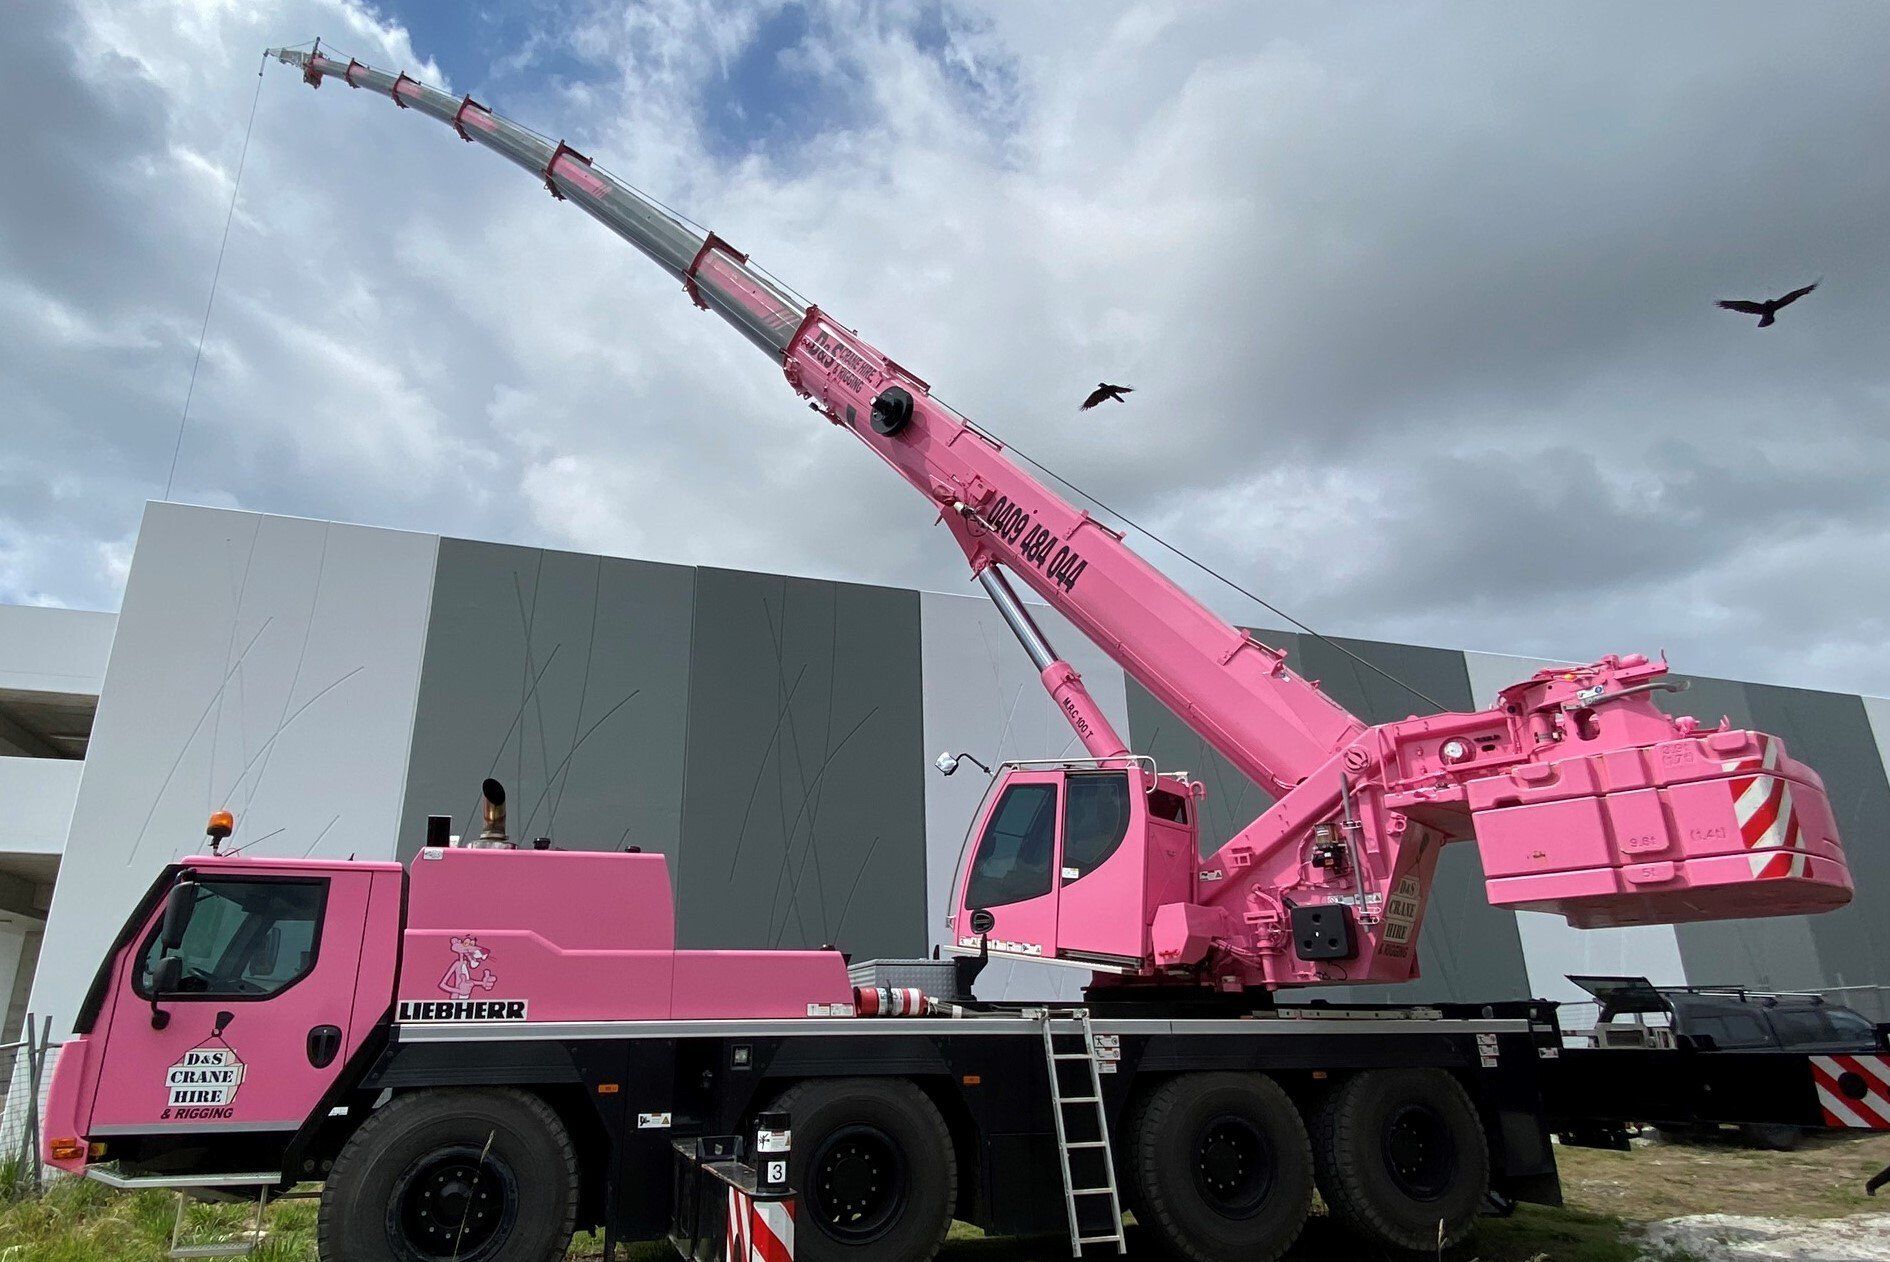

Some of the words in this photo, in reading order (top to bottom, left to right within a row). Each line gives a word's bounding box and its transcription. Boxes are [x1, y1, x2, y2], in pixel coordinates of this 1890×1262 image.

[807, 330, 845, 368] D&S
[987, 496, 1029, 545] 0409
[1019, 523, 1059, 569] 484
[1047, 545, 1088, 593] 044
[1076, 717, 1089, 733] 100
[1085, 730, 1094, 739] T
[1388, 899, 1417, 918] CRANE
[1385, 923, 1408, 939] HIRE
[400, 1001, 526, 1020] LIEBHERR
[186, 1053, 223, 1066] D&S
[170, 1070, 234, 1084] CRANE
[173, 1090, 223, 1103] HIRE
[161, 1108, 171, 1119] &
[174, 1107, 234, 1119] RIGGING
[772, 1164, 783, 1180] 3
